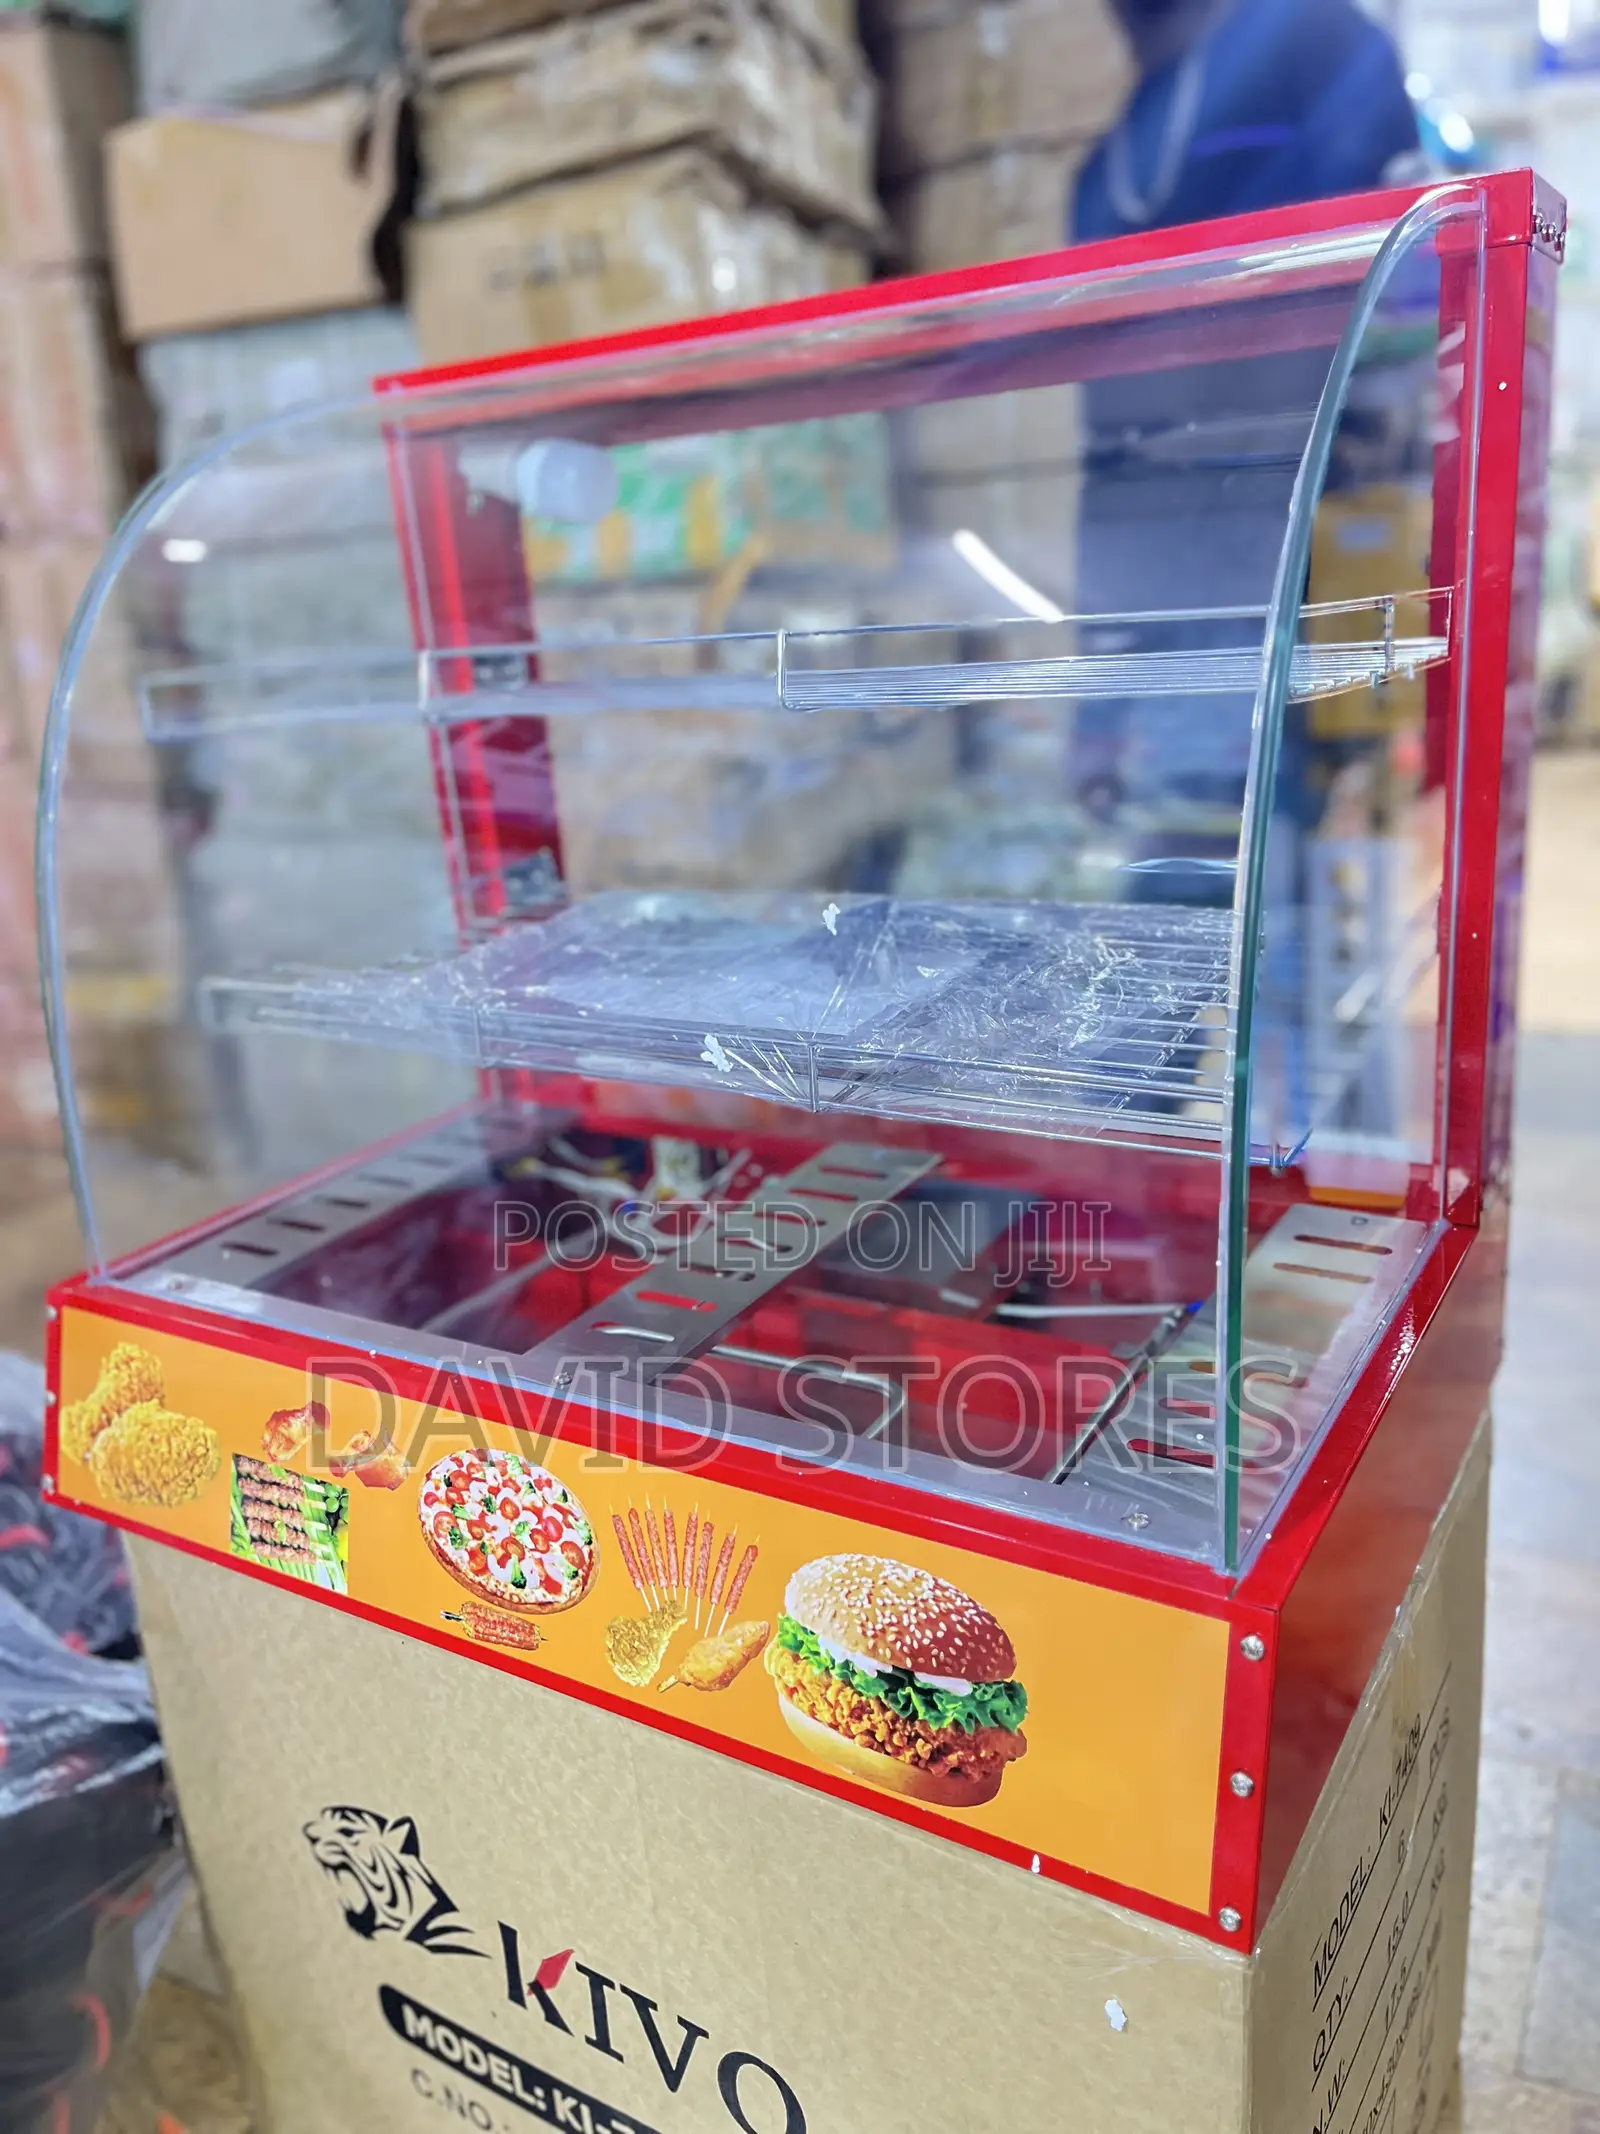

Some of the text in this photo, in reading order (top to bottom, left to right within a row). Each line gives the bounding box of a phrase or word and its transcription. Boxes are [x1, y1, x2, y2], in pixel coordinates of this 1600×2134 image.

[1313, 1845, 1371, 1998] MODEL:
[402, 2003, 548, 2111] MODEL:
[497, 1920, 807, 2134] KIVO
[1313, 1975, 1349, 2072] QTY:
